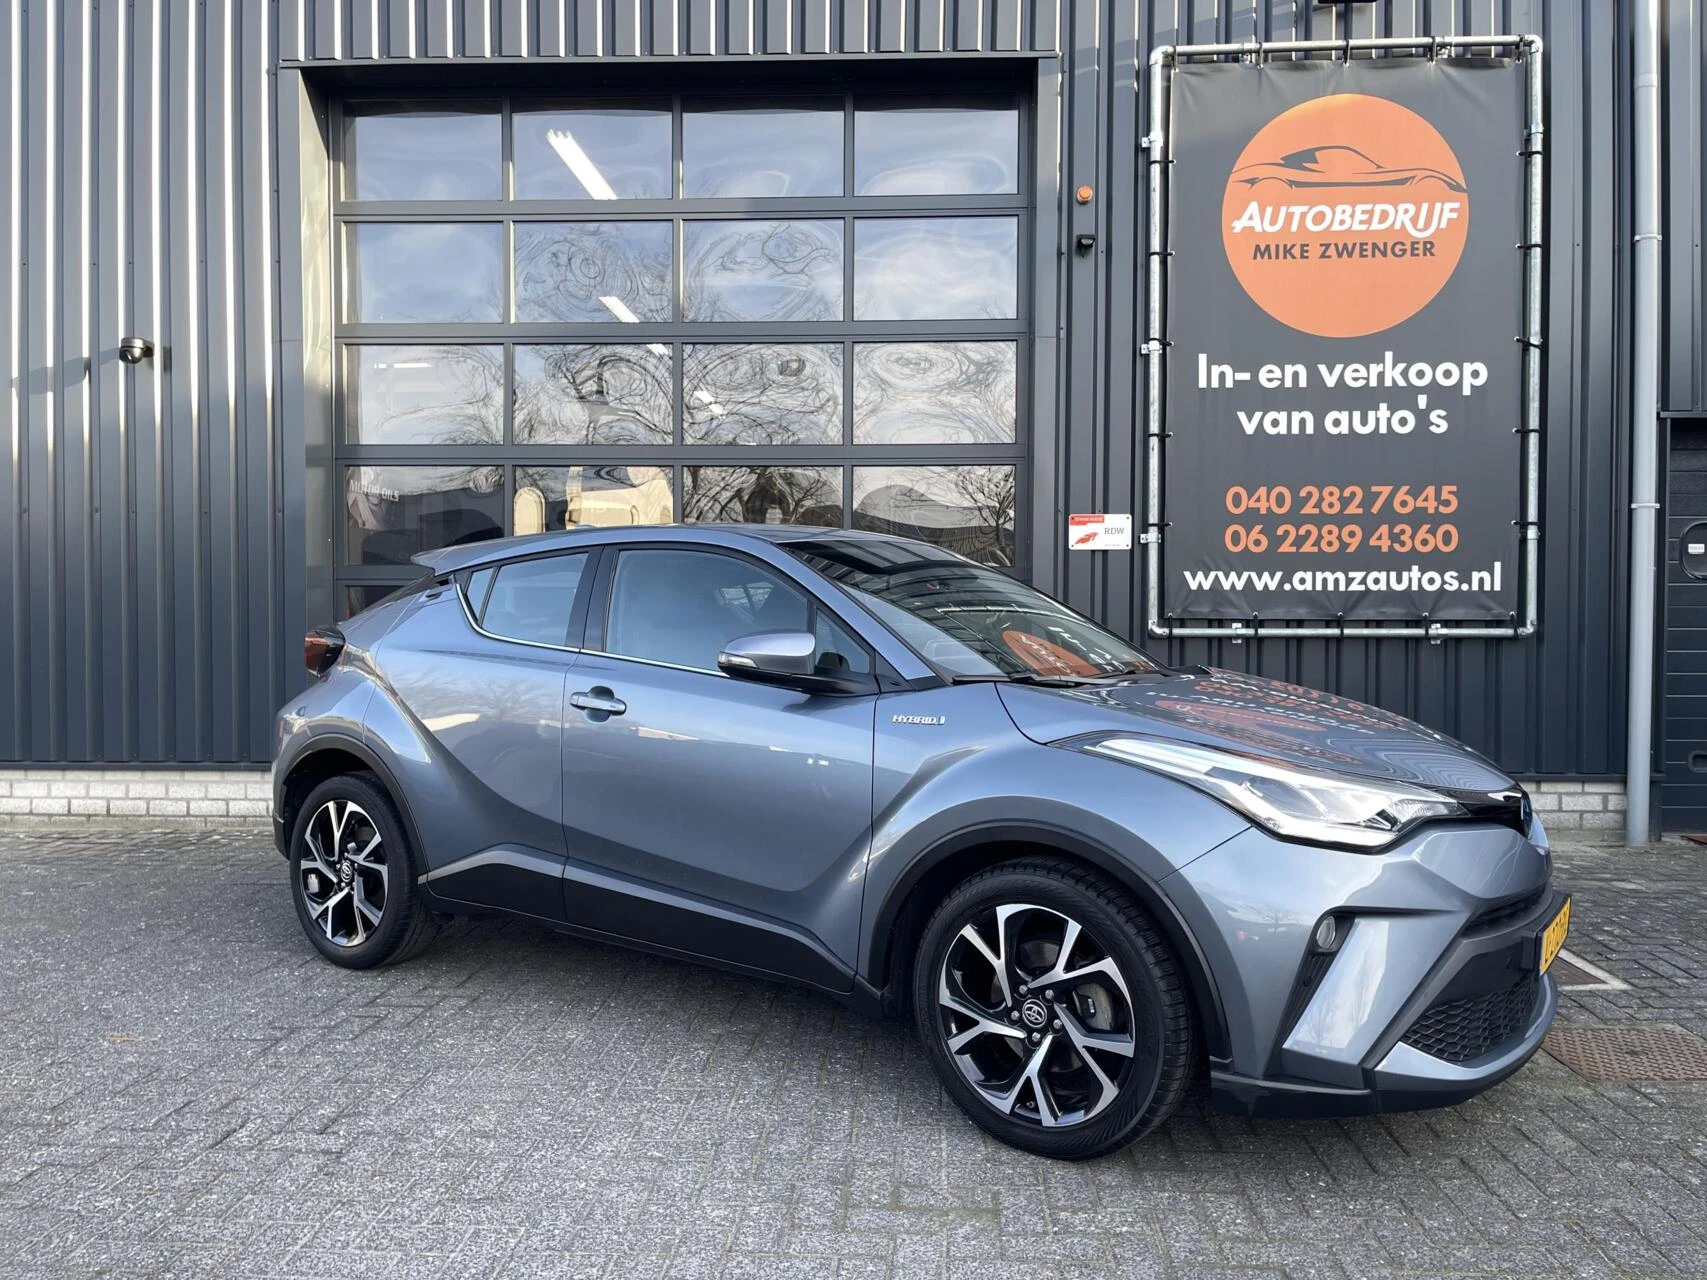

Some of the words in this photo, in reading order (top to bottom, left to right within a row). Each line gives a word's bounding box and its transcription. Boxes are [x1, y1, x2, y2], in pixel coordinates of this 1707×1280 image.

[1232, 200, 1460, 238] AUTOBEDRIJF
[1252, 243, 1310, 260] MIKE
[1319, 240, 1436, 259] ZWENGER
[1198, 353, 1251, 389] In-
[1258, 363, 1308, 388] en
[1317, 351, 1488, 396] verkoop
[1236, 411, 1315, 436] van
[1324, 394, 1449, 435] auto's
[1225, 486, 1292, 515] 040
[1299, 486, 1363, 514] 282
[1370, 485, 1459, 514] 7645
[1104, 527, 1125, 535] RDW
[1224, 524, 1269, 553] 06
[1276, 524, 1363, 553] 2289
[1369, 524, 1460, 553] 4360
[1183, 561, 1502, 592] www.amzautos.nl
